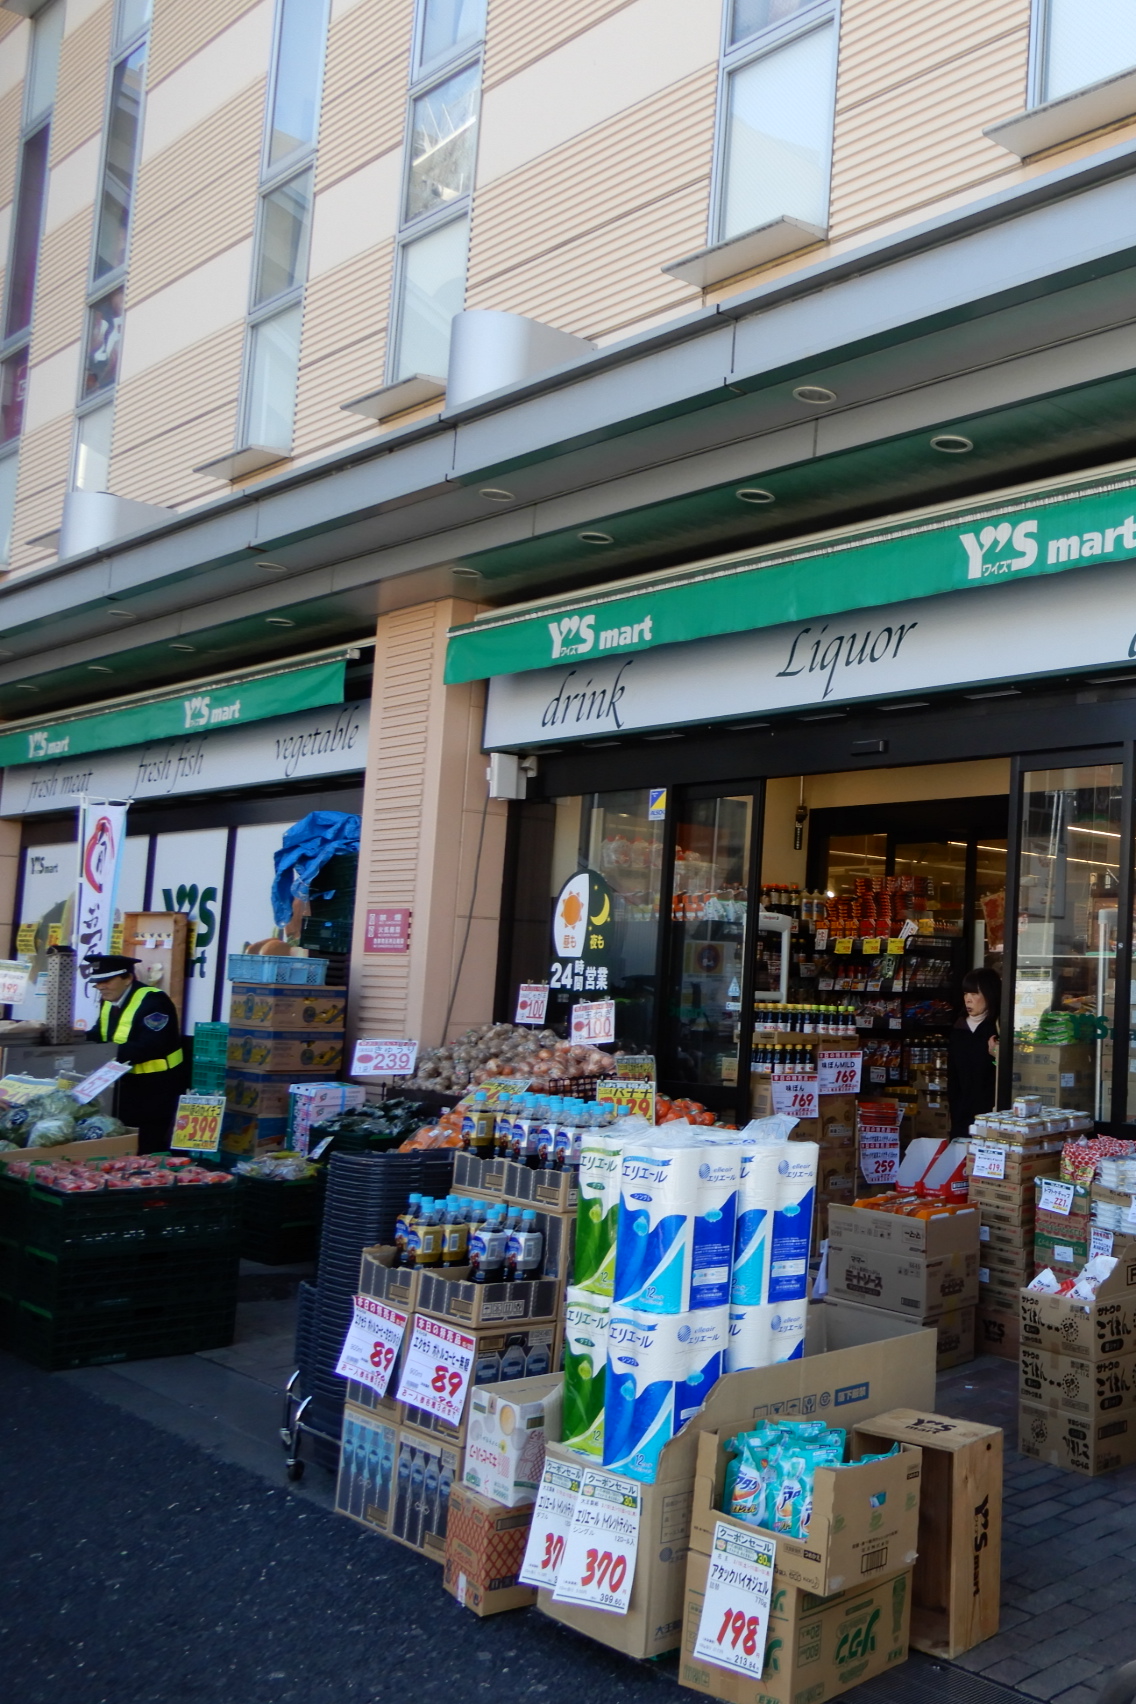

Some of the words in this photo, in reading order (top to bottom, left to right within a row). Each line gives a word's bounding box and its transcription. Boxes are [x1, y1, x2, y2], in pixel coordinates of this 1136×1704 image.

[982, 561, 1012, 576] ワイズ
[599, 615, 653, 650] mart
[776, 622, 918, 699] Liquor
[541, 660, 634, 729] drink
[211, 699, 240, 723] mart
[48, 736, 69, 755] mart
[275, 705, 360, 778] vegetable
[131, 742, 174, 800] fresh
[167, 737, 207, 792] fish
[24, 761, 59, 811] fresh
[61, 769, 94, 793] meat
[373, 1053, 410, 1069] 239
[835, 1070, 857, 1083] 169
[791, 1093, 814, 1107] 169
[188, 1116, 218, 1140] 399
[581, 1156, 617, 1172] エリエール
[622, 1165, 668, 1183] エリエール
[874, 1160, 895, 1174] 259
[707, 1174, 736, 1182] エリエール
[1054, 1197, 1067, 1207] 221
[846, 1269, 883, 1289] ミートソース
[647, 1287, 656, 1298] 12
[567, 1310, 608, 1329] エリエール
[418, 1318, 461, 1346] 本日の特売品
[609, 1323, 653, 1348] エリエール
[687, 1333, 720, 1344] エリエール
[370, 1341, 394, 1372] 89
[431, 1365, 463, 1398] 89
[634, 1454, 644, 1465] 12
[587, 1475, 636, 1495] クーポンセール
[576, 1510, 601, 1526] エリエール
[719, 1528, 772, 1552] クーポンセール
[541, 1532, 566, 1572] 37
[581, 1548, 627, 1593] 370
[711, 1563, 768, 1595] アタックバイオジェル
[716, 1607, 760, 1656] 198
